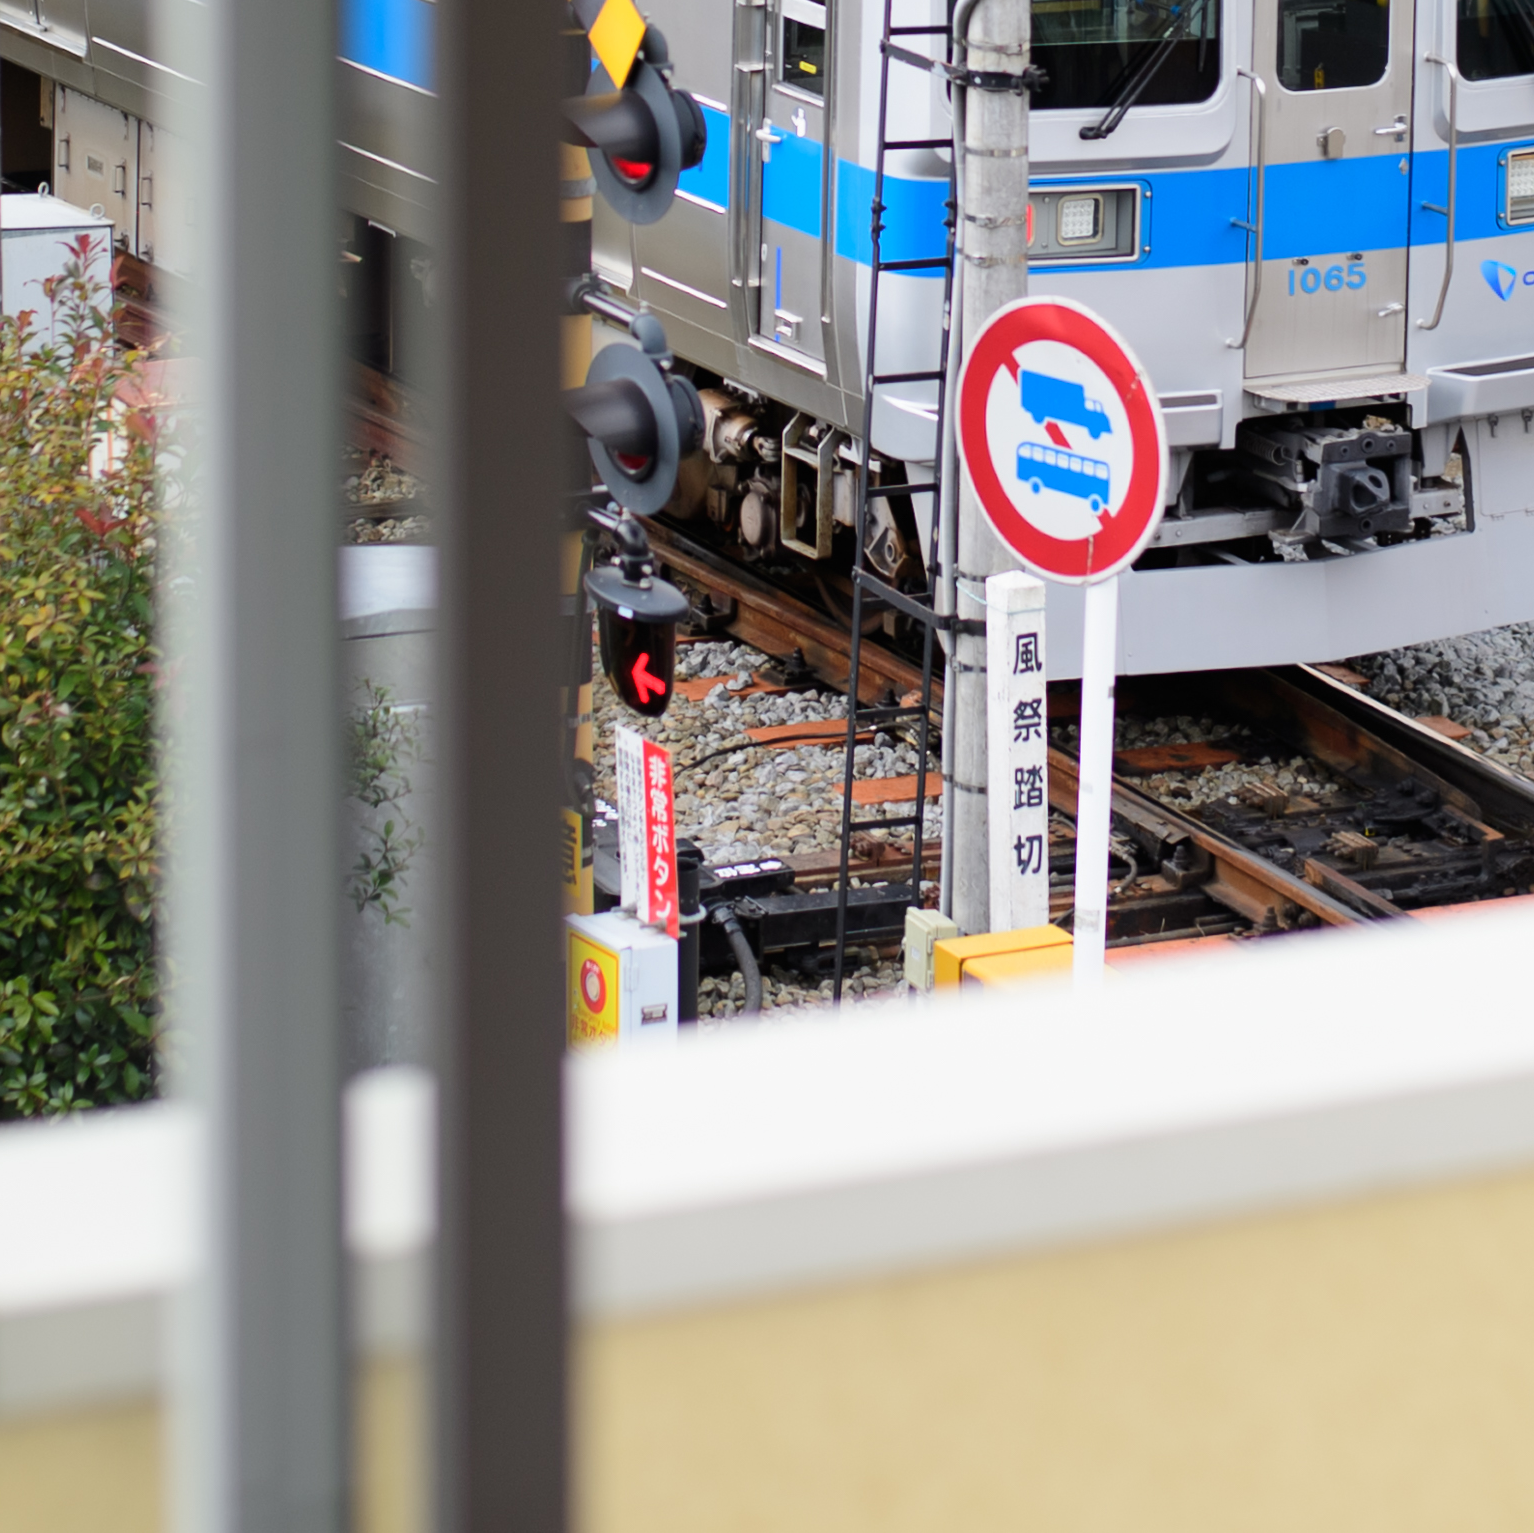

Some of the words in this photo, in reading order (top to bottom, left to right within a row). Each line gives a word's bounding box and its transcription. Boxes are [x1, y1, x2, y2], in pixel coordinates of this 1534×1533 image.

[1287, 262, 1367, 296] 1065
[1012, 631, 1044, 875] 風祭踏切
[647, 754, 673, 918] 非常ボタン
